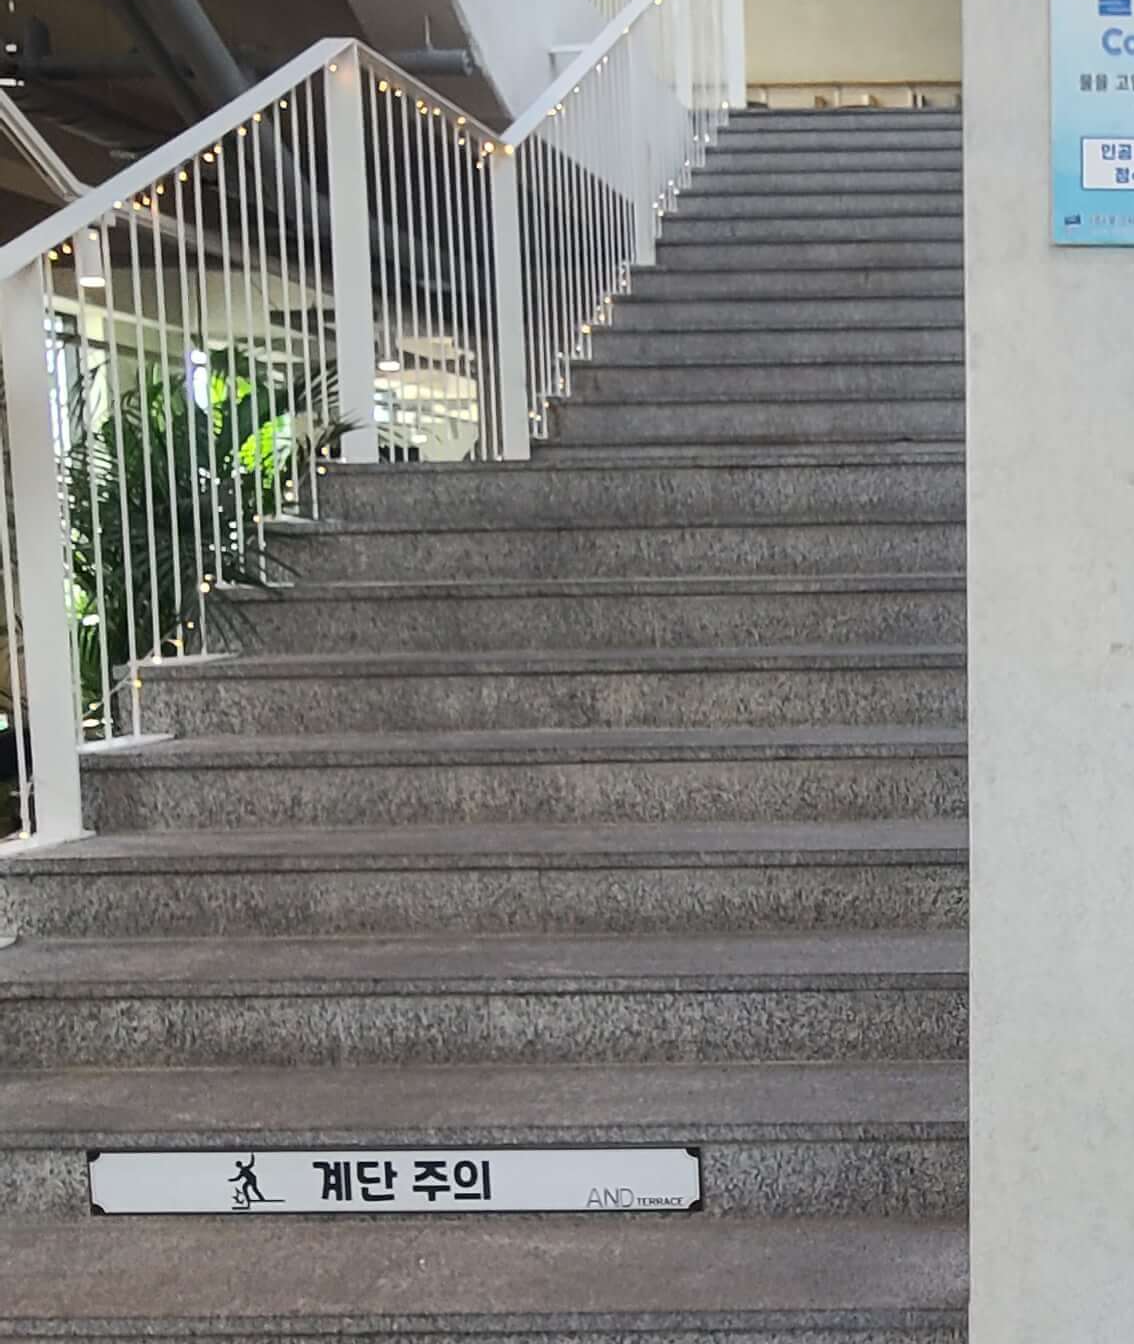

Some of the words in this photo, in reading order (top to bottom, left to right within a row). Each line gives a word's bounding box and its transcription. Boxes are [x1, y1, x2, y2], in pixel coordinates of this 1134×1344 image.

[312, 1161, 398, 1201] 계단
[412, 1160, 492, 1201] 주의
[586, 1187, 635, 1208] AND
[637, 1197, 684, 1207] TERRACE
